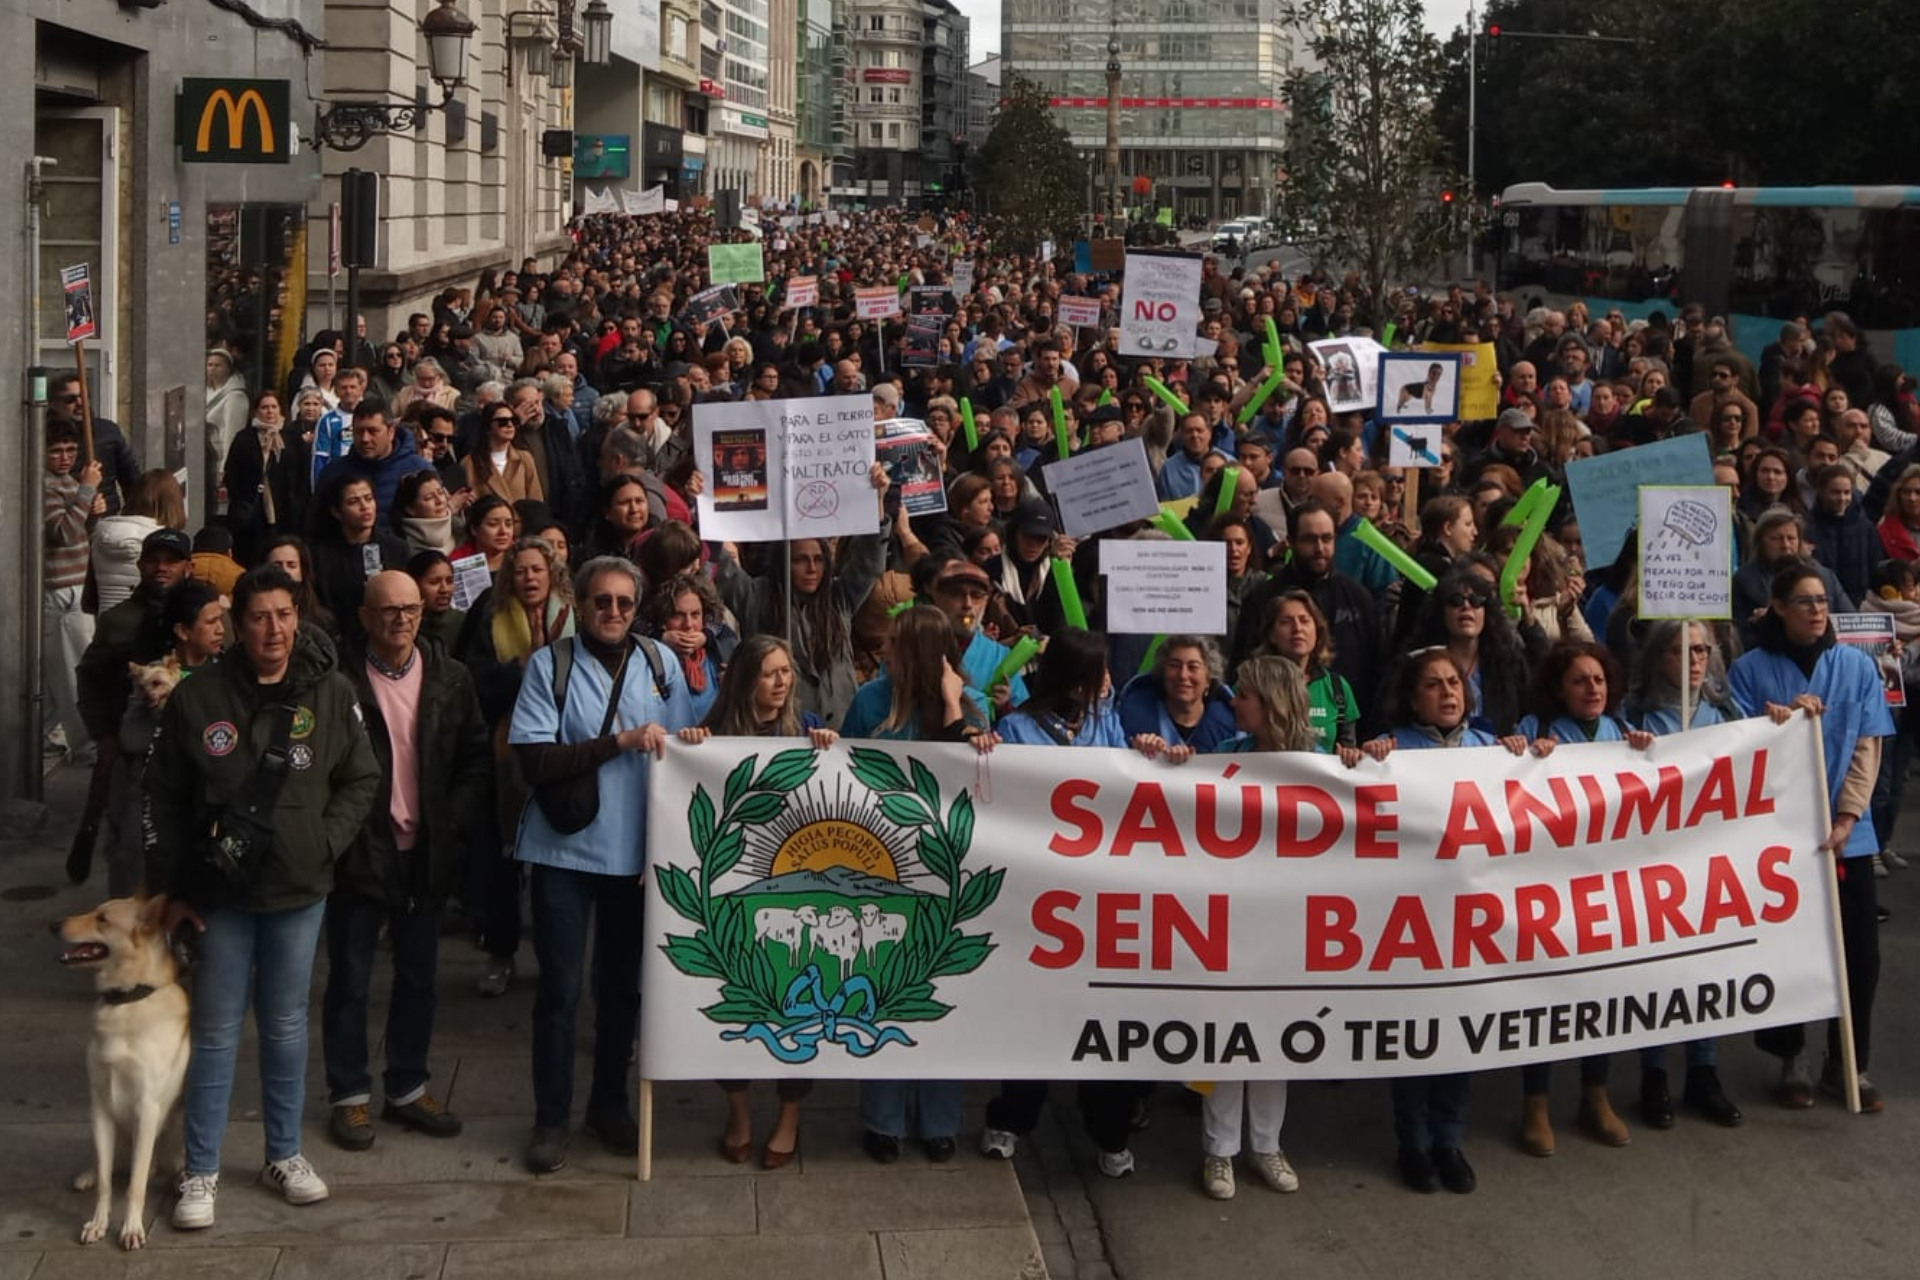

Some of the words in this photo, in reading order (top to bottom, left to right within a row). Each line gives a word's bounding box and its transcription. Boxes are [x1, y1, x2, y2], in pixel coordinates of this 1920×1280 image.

[1134, 300, 1177, 322] NO
[781, 414, 810, 427] PARA
[817, 413, 834, 425] EL
[788, 433, 814, 444] PARA
[820, 432, 832, 443] EL
[837, 429, 871, 441] GATO
[782, 460, 867, 479] MALTRATO
[1645, 591, 1675, 601] DECIR
[1048, 762, 1399, 860] SAÚDE
[1435, 748, 1776, 859] ANIMAL
[785, 828, 824, 858] HIGIA
[827, 826, 884, 860] PECORIS
[791, 839, 829, 870] SALUS
[833, 839, 876, 871] POPULI
[1028, 890, 1229, 972] SEN
[1305, 846, 1800, 972] BARREIRAS
[1071, 1019, 1262, 1065] APOIA
[1280, 1006, 1332, 1064] Ó
[1344, 1018, 1440, 1061] TEU
[1459, 973, 1776, 1055] VETERINARIO
